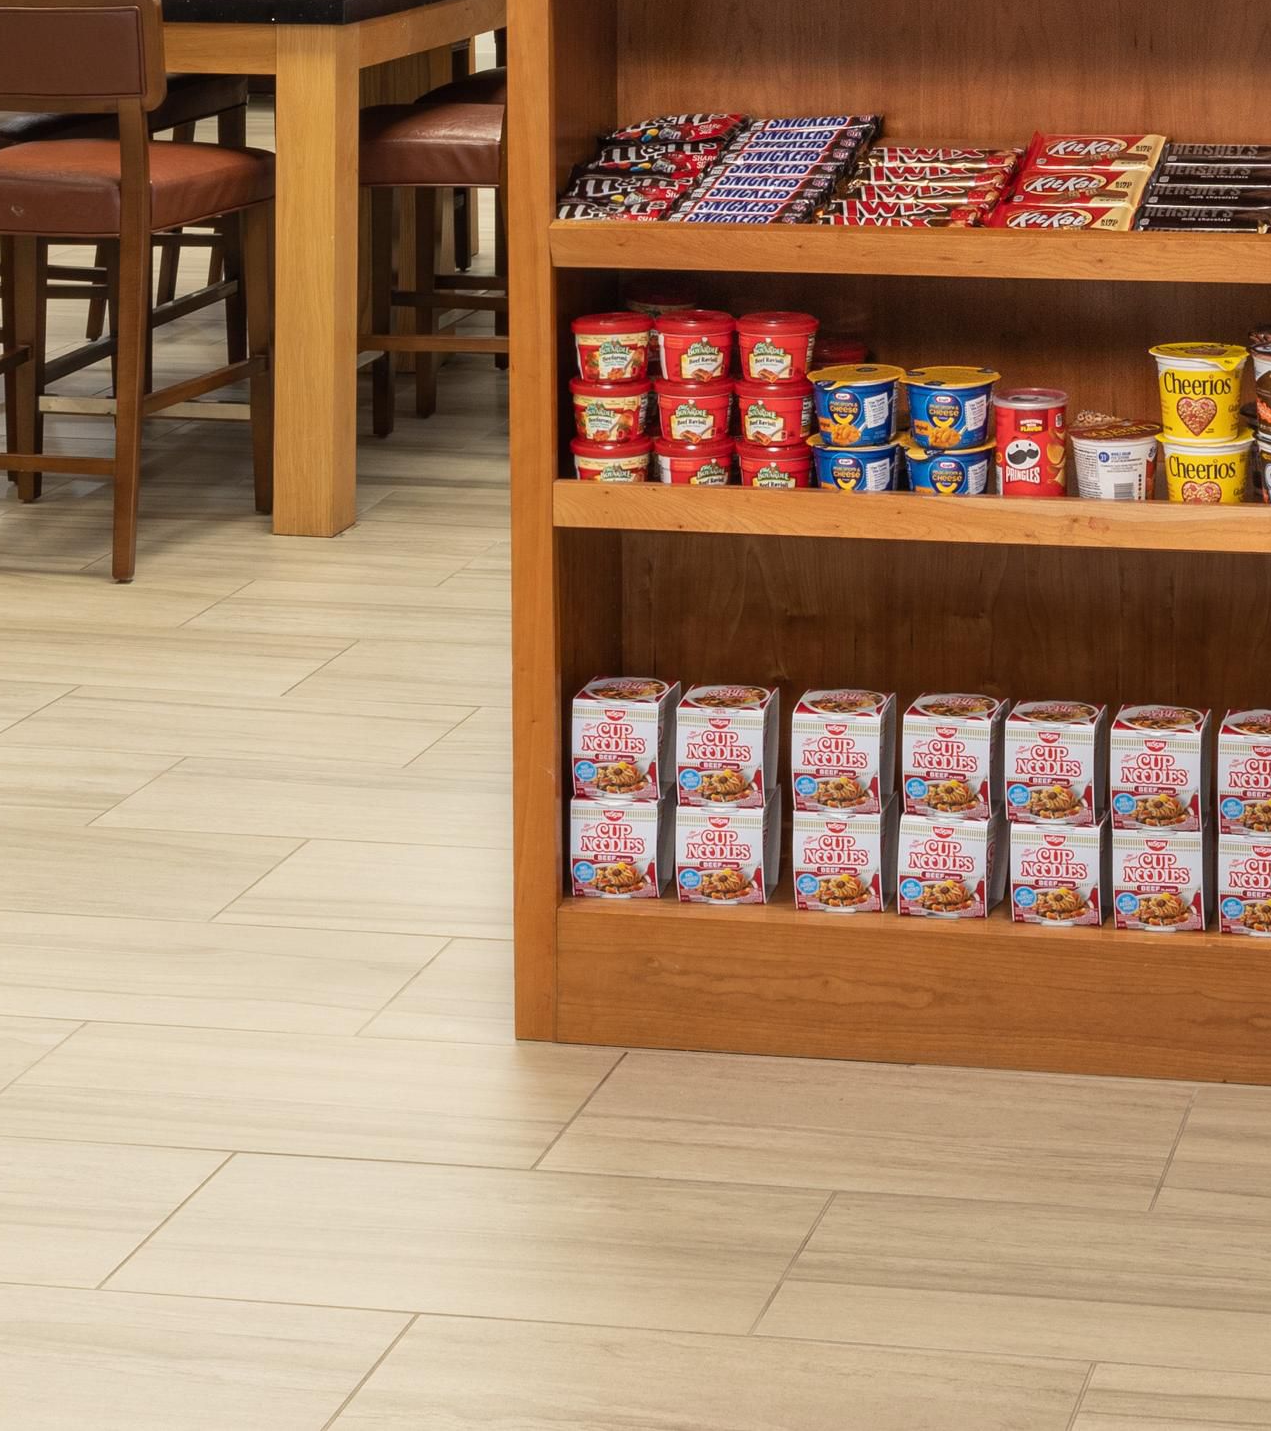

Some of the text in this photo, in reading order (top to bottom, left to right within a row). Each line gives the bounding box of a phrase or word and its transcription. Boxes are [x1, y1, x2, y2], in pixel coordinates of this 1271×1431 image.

[884, 147, 984, 166] TWIX
[1048, 140, 1122, 156] KitKat
[1026, 177, 1102, 191] KitKat
[844, 199, 947, 217] TWIX
[1008, 212, 1085, 228] KitKat
[1164, 372, 1232, 396] Cheerios
[929, 408, 960, 417] Cheese
[1005, 466, 1040, 484] PRINGLES
[1169, 457, 1236, 479] Cheerios
[597, 723, 633, 738] CUP
[702, 731, 739, 745] CUP
[582, 736, 646, 754] NOODLES
[687, 744, 751, 761] NOODLES
[818, 737, 855, 752] CUP
[928, 740, 965, 755] CUP
[1031, 745, 1068, 761] CUP
[803, 751, 867, 768] NOODLES
[913, 753, 977, 772] NOODLES
[1016, 759, 1081, 777] NOODLES
[1136, 753, 1175, 769] CUP
[1121, 767, 1188, 786] NOODLES
